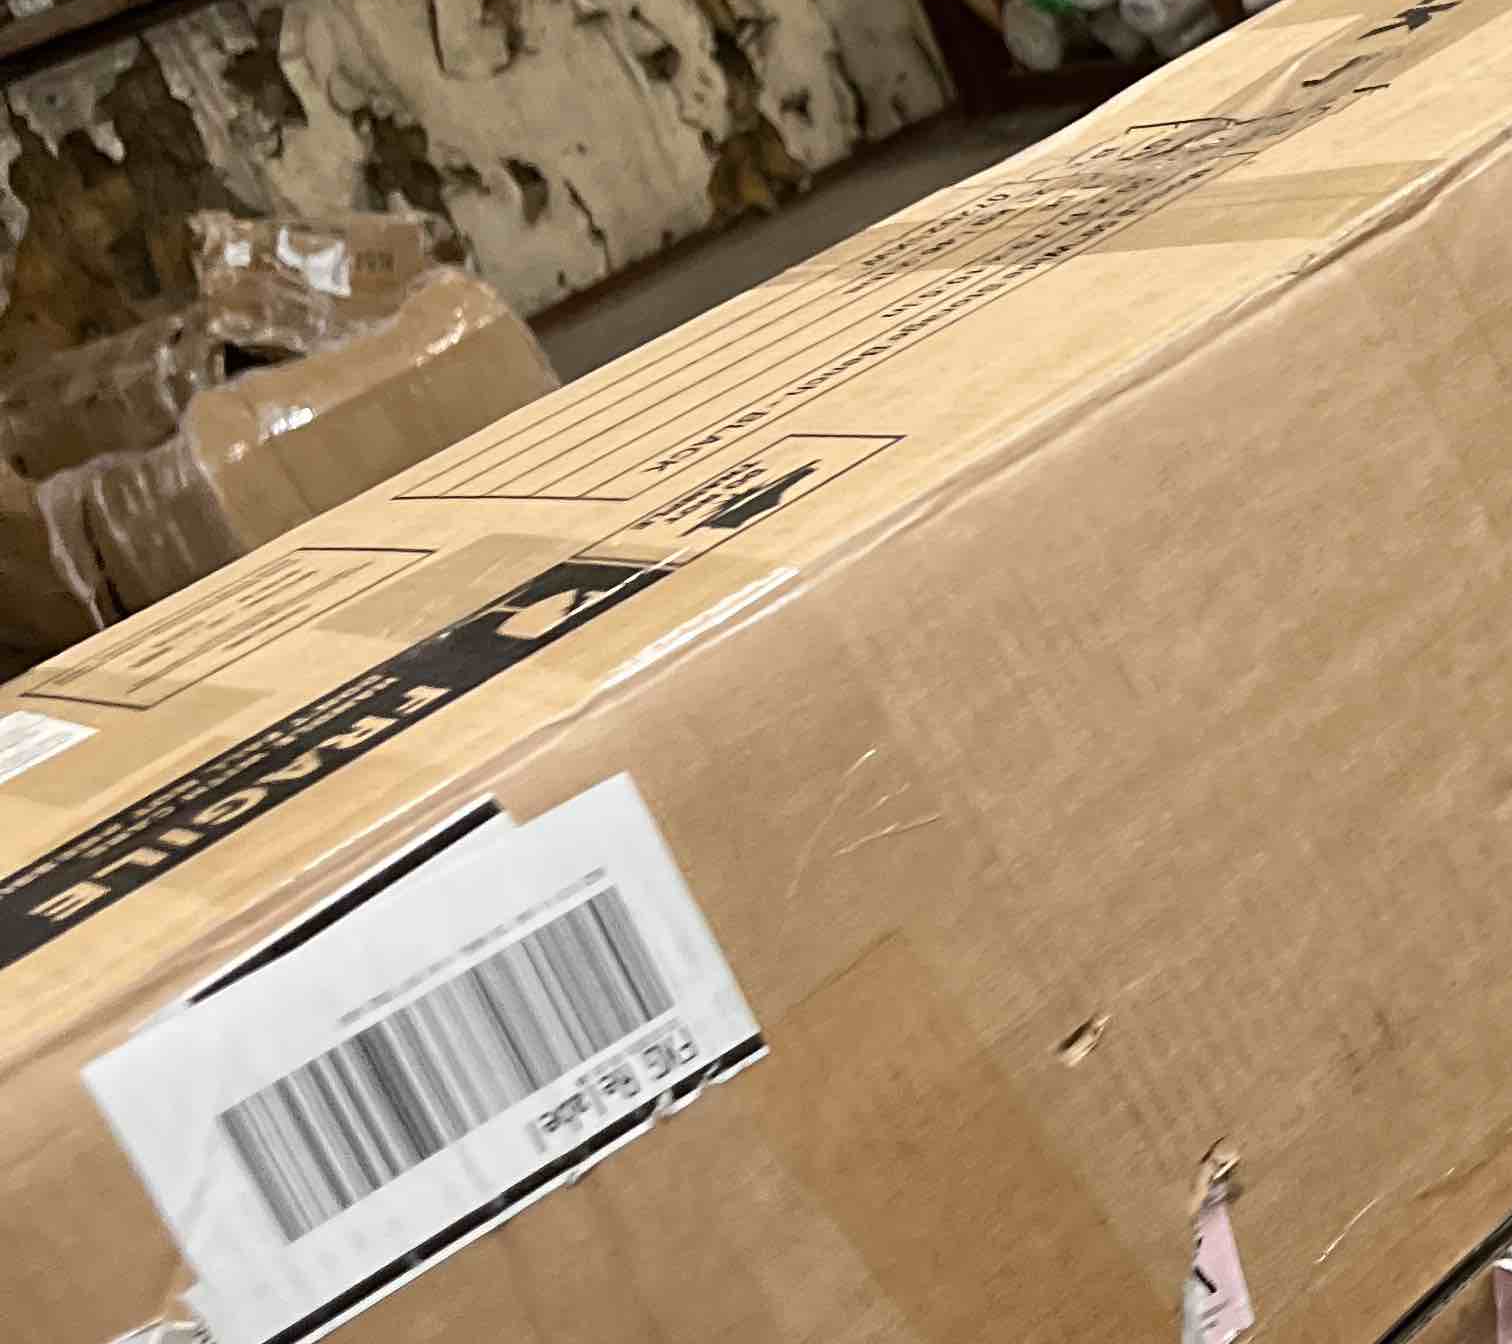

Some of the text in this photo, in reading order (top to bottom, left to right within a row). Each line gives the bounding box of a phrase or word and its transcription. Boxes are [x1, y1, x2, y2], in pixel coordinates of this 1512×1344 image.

[781, 344, 895, 396] Bench
[647, 411, 771, 473] BLACK
[18, 683, 459, 922] FRAGILE
